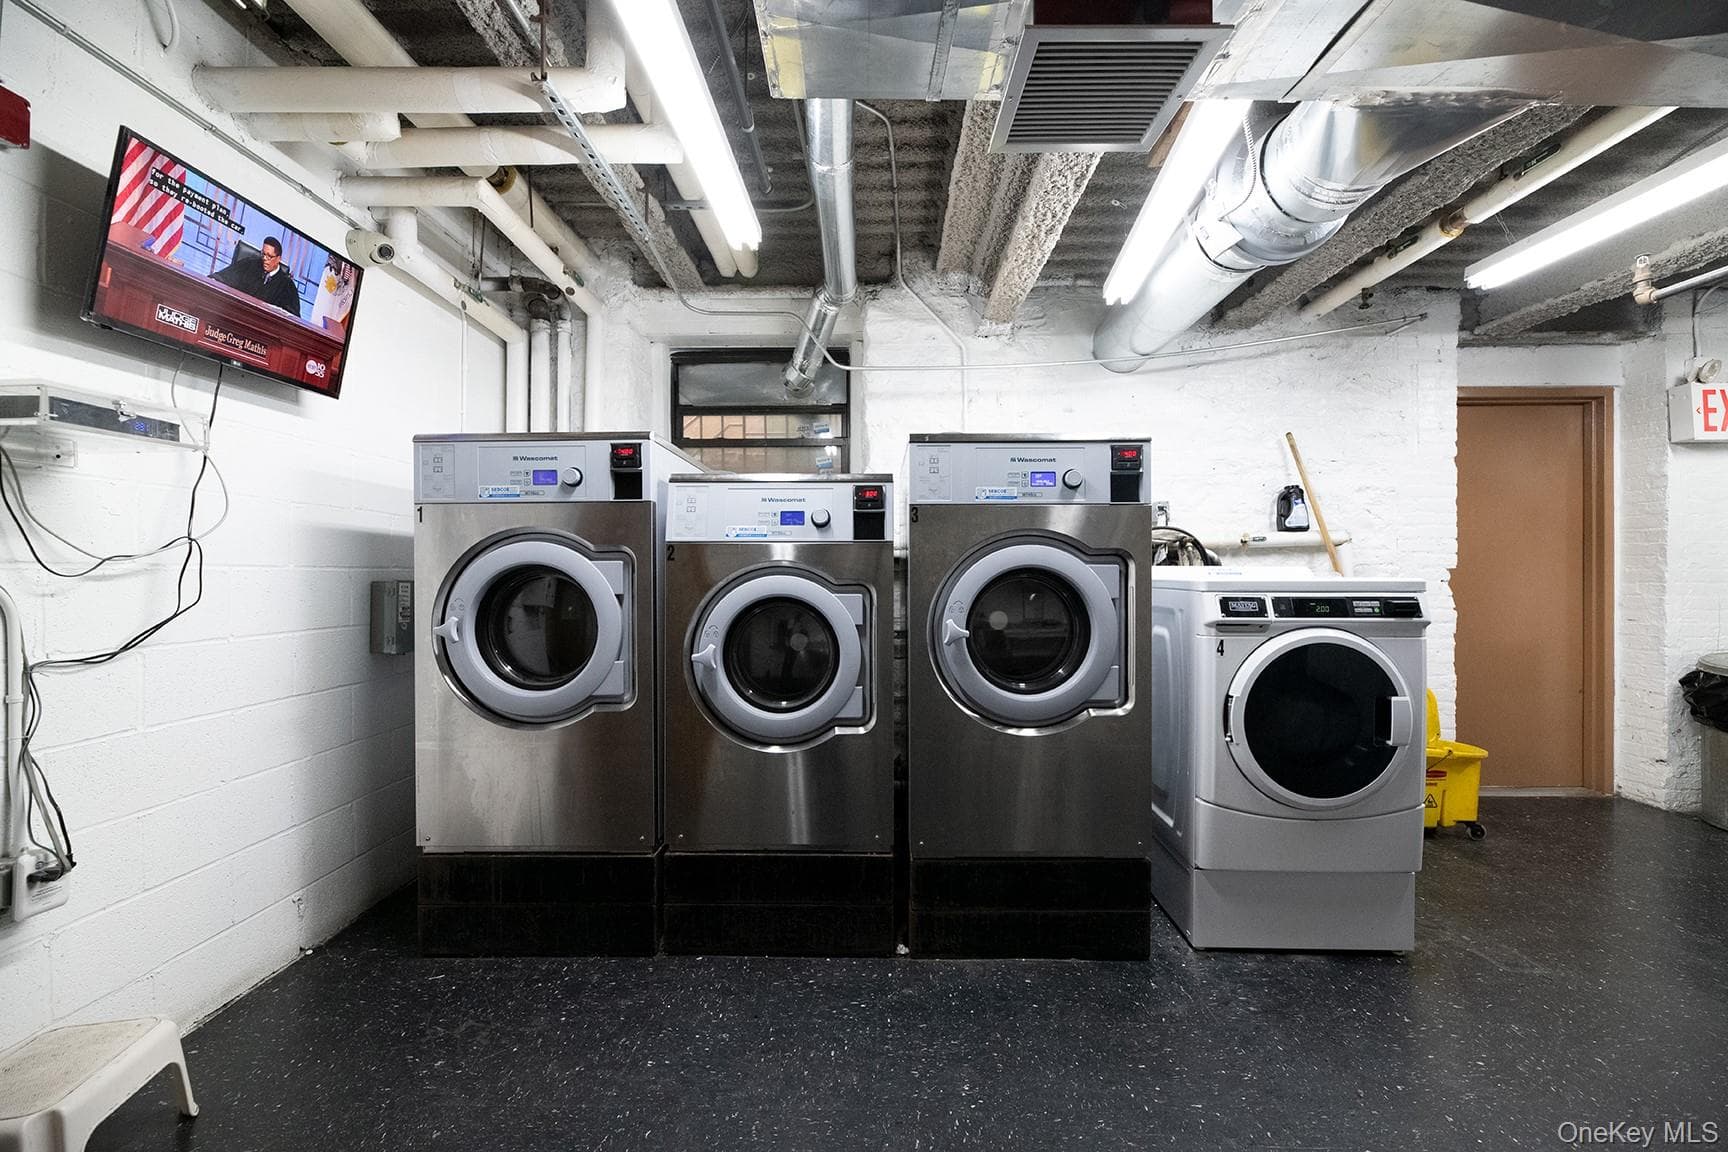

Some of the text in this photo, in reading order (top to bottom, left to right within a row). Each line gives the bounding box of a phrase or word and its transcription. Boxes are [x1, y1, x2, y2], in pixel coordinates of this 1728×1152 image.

[151, 169, 164, 180] for
[168, 178, 180, 189] the
[183, 187, 209, 206] payment
[162, 186, 177, 198] they
[218, 216, 228, 226] the
[205, 326, 267, 355] Judge Greg Mathis
[417, 506, 423, 523] 1
[911, 507, 918, 523] 3
[667, 544, 675, 561] 2
[1217, 639, 1225, 656] 4
